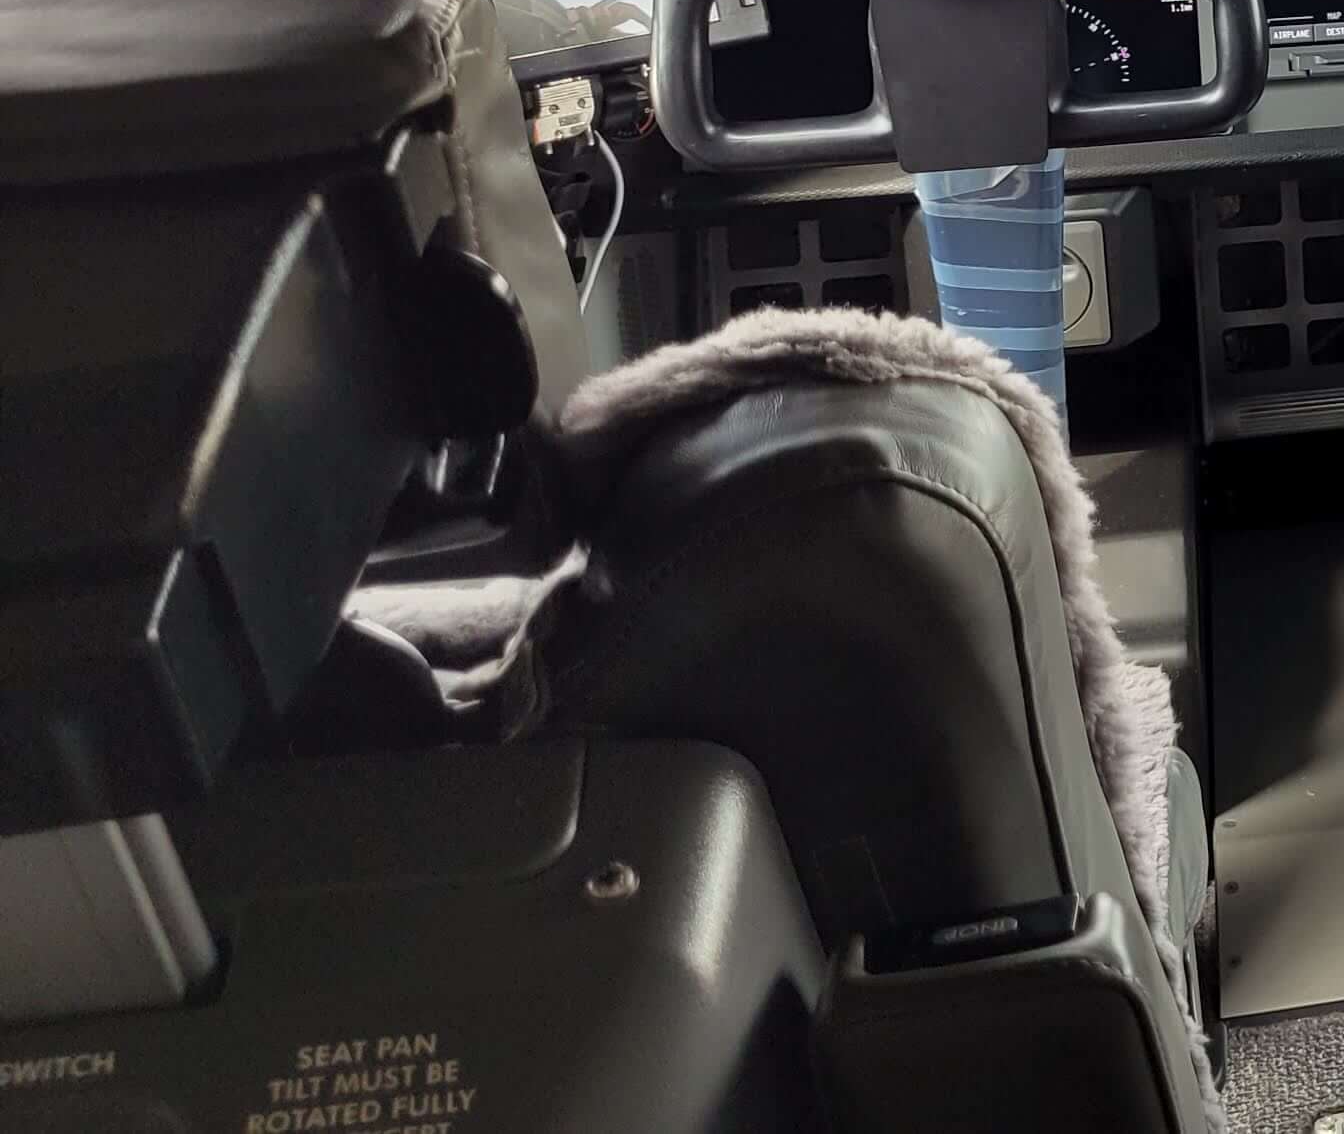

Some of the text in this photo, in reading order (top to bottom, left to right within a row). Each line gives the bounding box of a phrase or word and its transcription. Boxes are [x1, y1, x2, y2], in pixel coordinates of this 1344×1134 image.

[1273, 30, 1311, 40] AIRPLANE
[297, 1033, 438, 1069] SEAT PAN
[268, 1061, 461, 1103] TILT MUST BE
[247, 1089, 477, 1134] ROTATED FULLY
